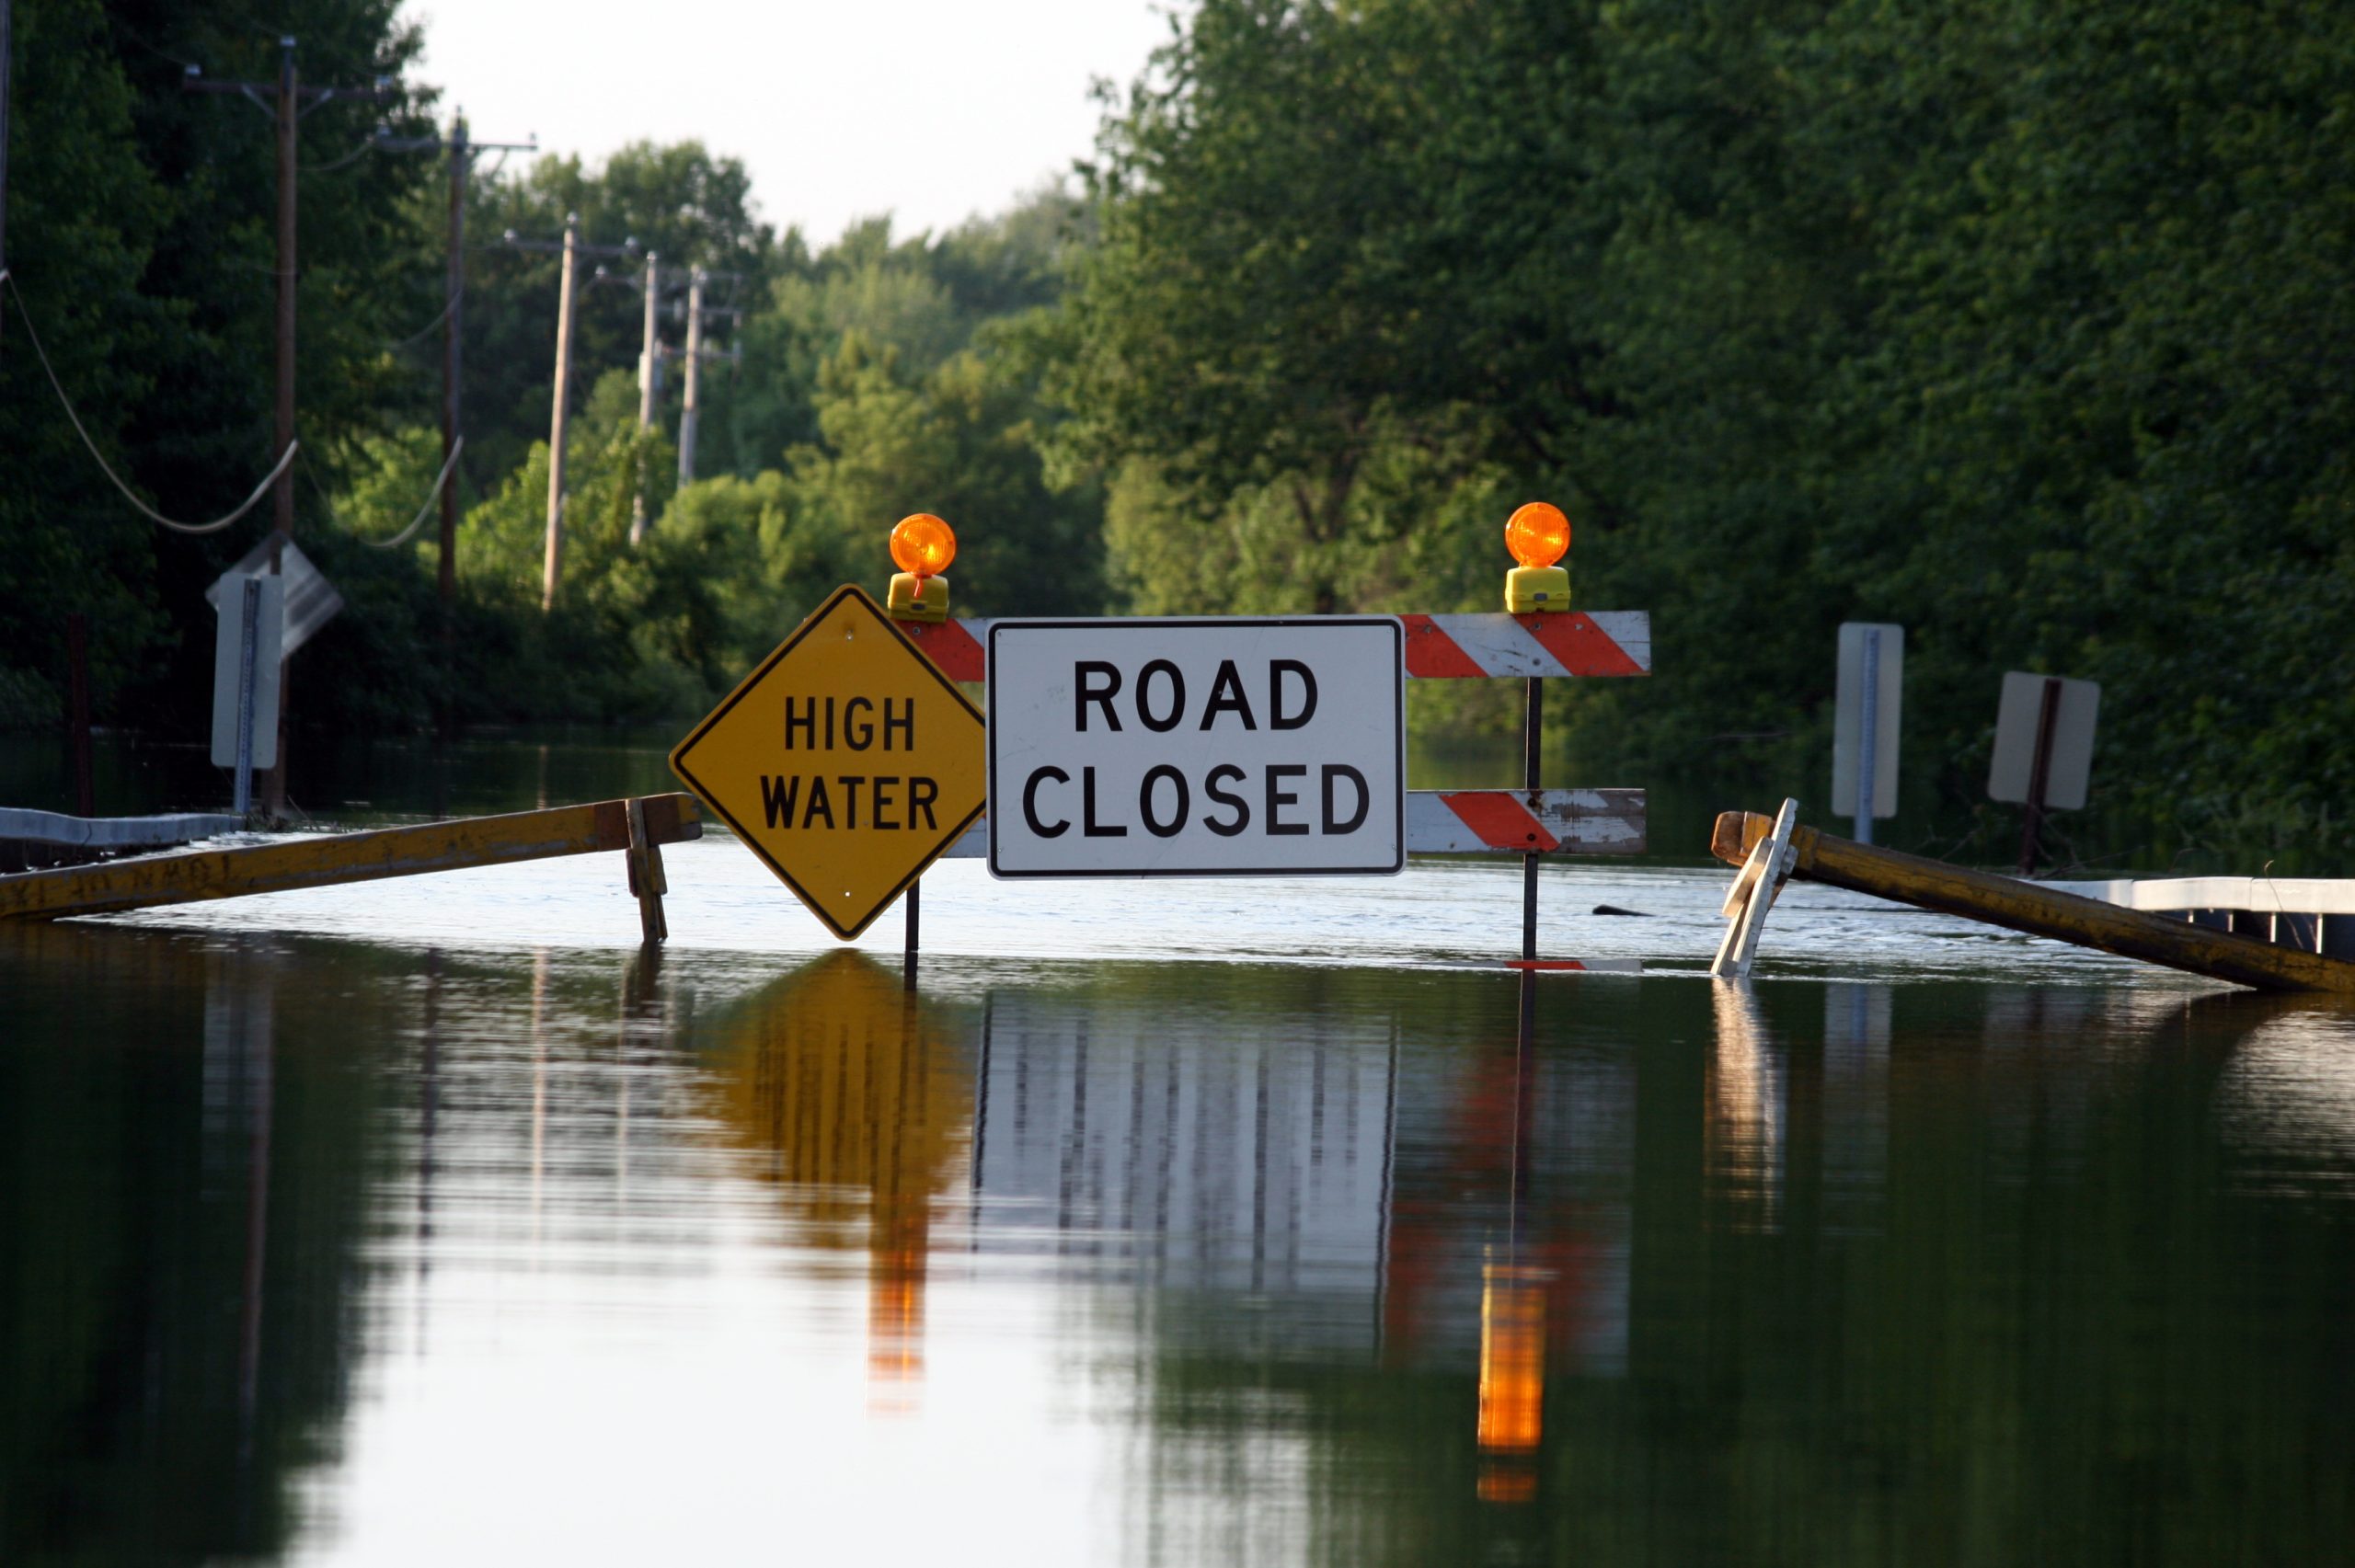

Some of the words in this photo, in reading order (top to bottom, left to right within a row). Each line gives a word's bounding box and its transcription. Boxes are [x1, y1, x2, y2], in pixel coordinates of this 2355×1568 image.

[786, 696, 913, 751] HIGH
[1075, 659, 1317, 732] ROAD
[760, 774, 939, 831] WATER
[1023, 764, 1369, 839] CLOSED
